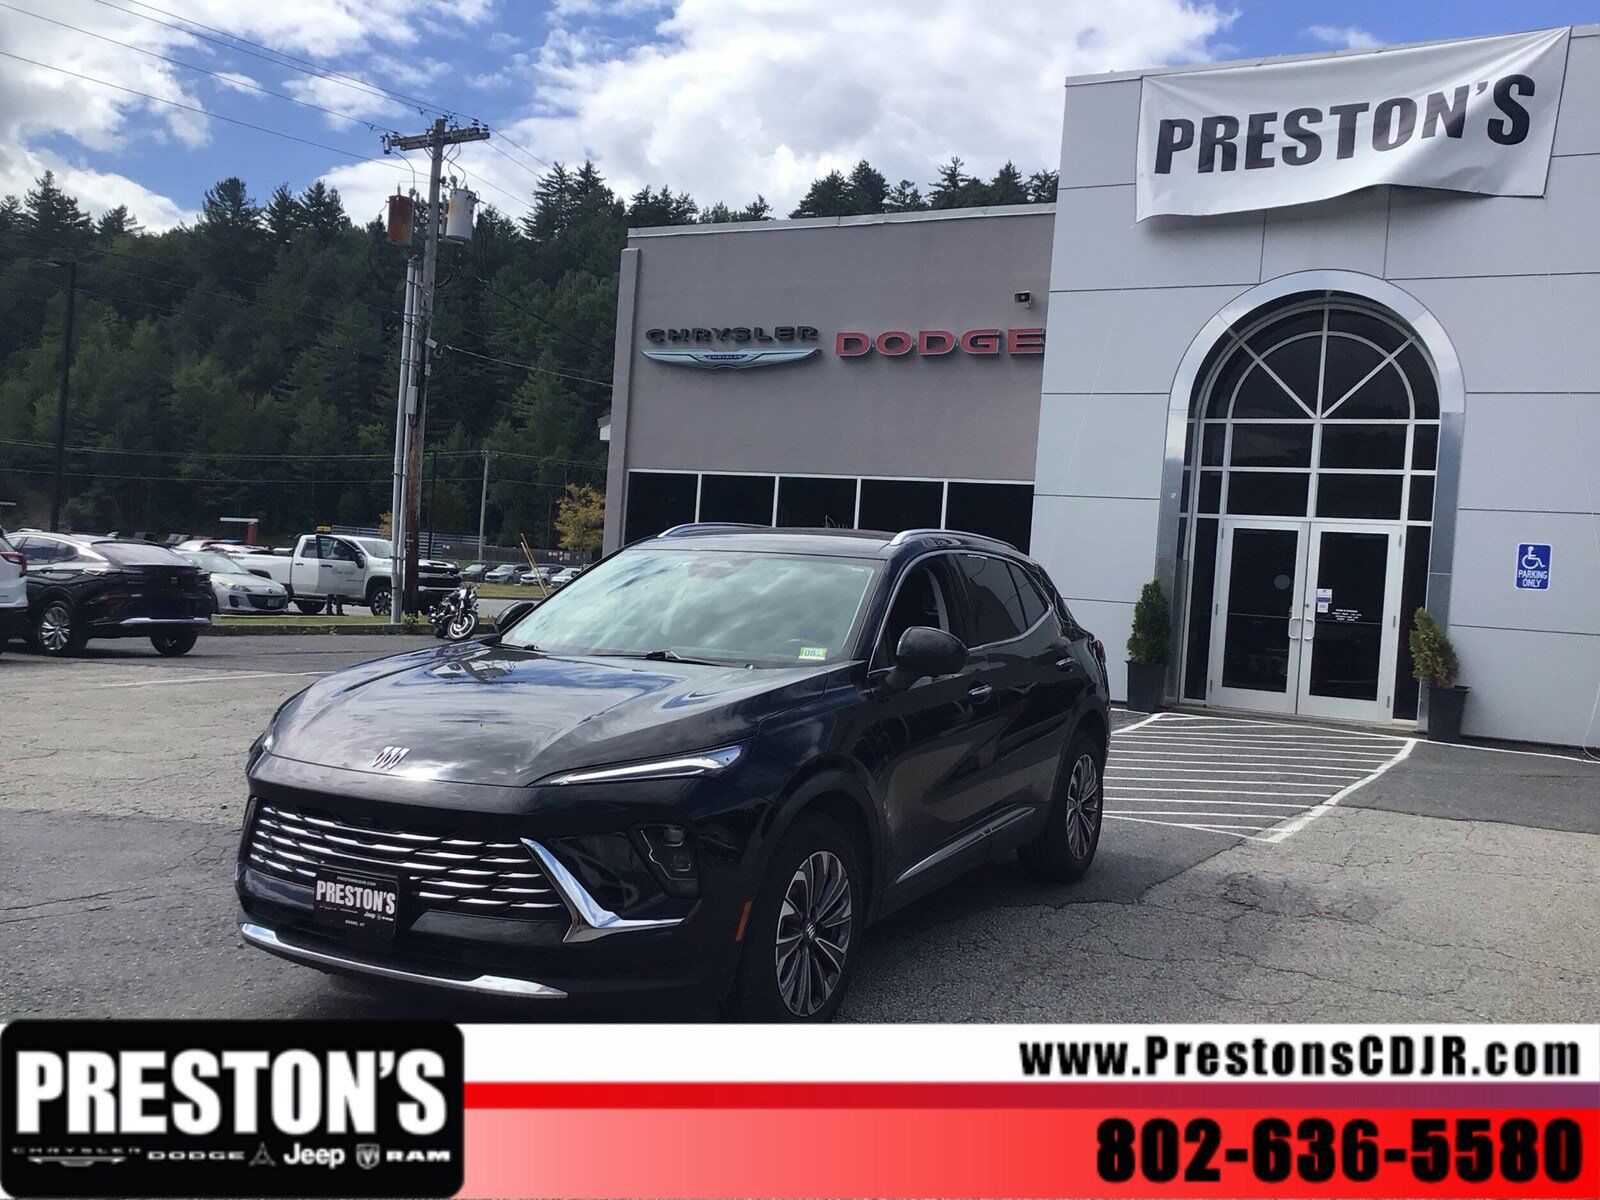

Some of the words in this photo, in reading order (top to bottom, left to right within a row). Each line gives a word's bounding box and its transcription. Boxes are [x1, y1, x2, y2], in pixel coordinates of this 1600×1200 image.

[1154, 73, 1536, 175] PRESTON'S
[645, 325, 819, 344] CHRYSLER
[834, 328, 1045, 358] DODGE
[1518, 569, 1548, 580] PARKING
[1522, 578, 1542, 587] ONLY
[316, 880, 396, 915] PRESTON'S
